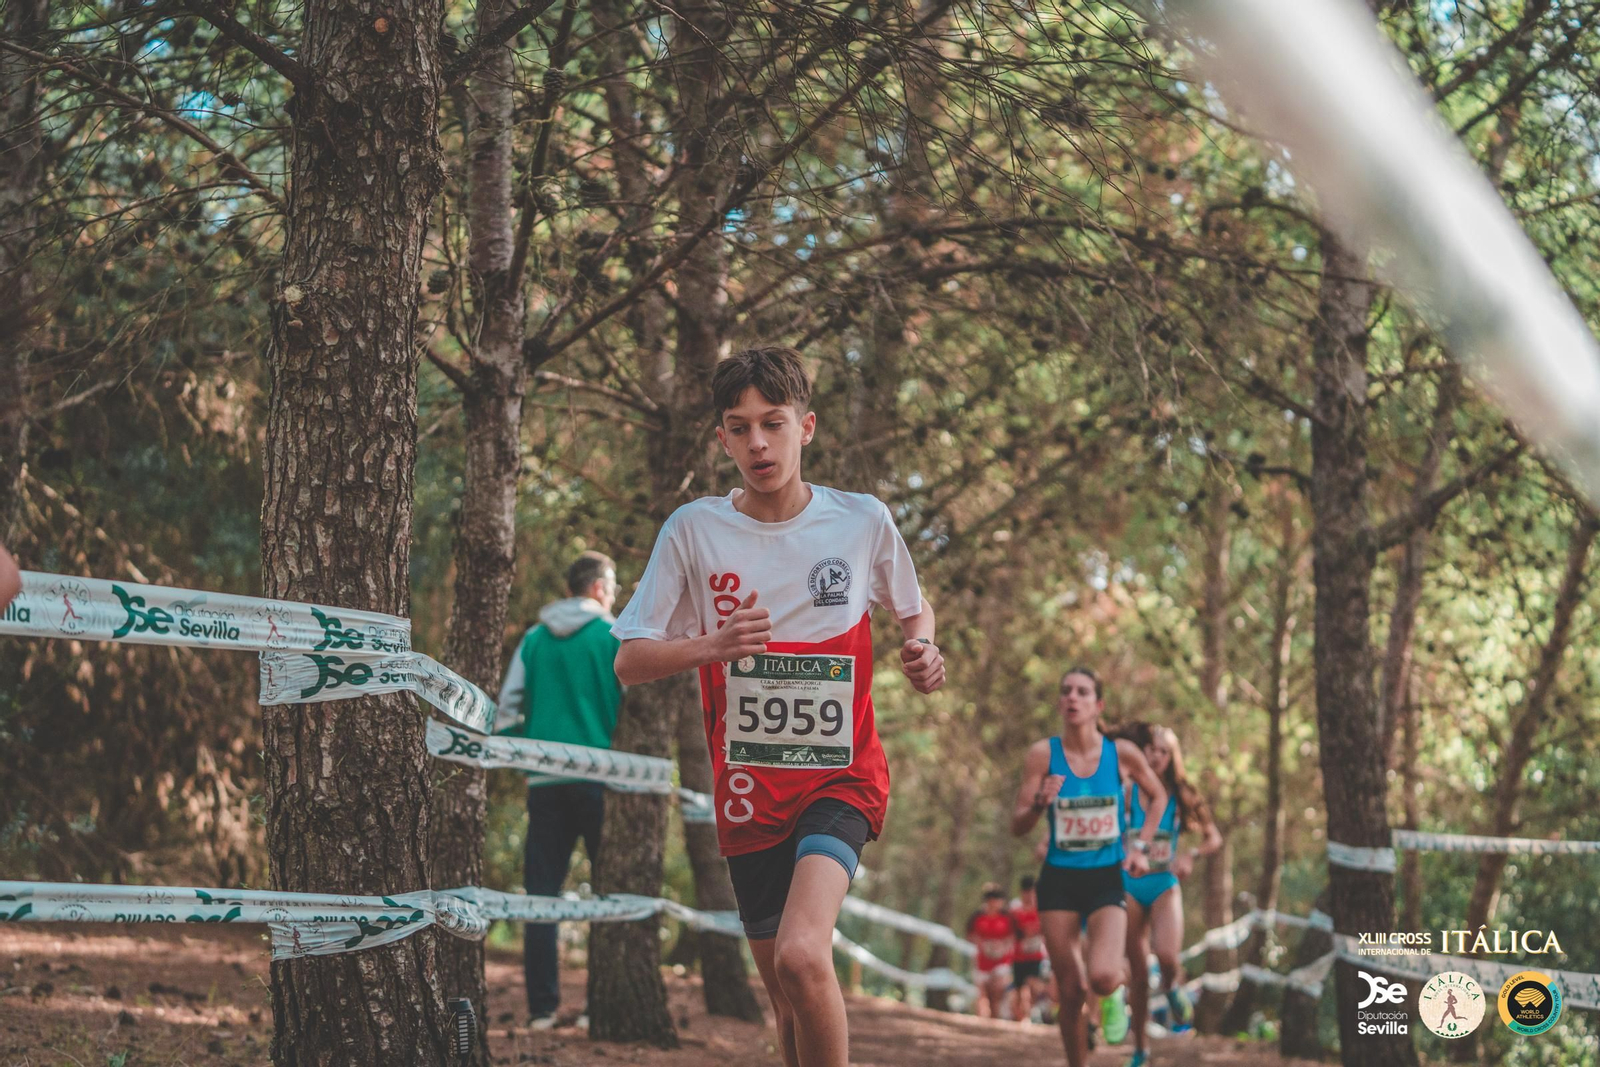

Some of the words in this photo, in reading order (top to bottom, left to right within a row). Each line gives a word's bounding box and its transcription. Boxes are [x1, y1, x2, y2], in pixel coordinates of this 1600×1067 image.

[179, 618, 240, 641] Sevilla
[763, 657, 822, 672] ITÁLICA
[738, 696, 843, 736] 5959
[1063, 814, 1114, 836] 7509
